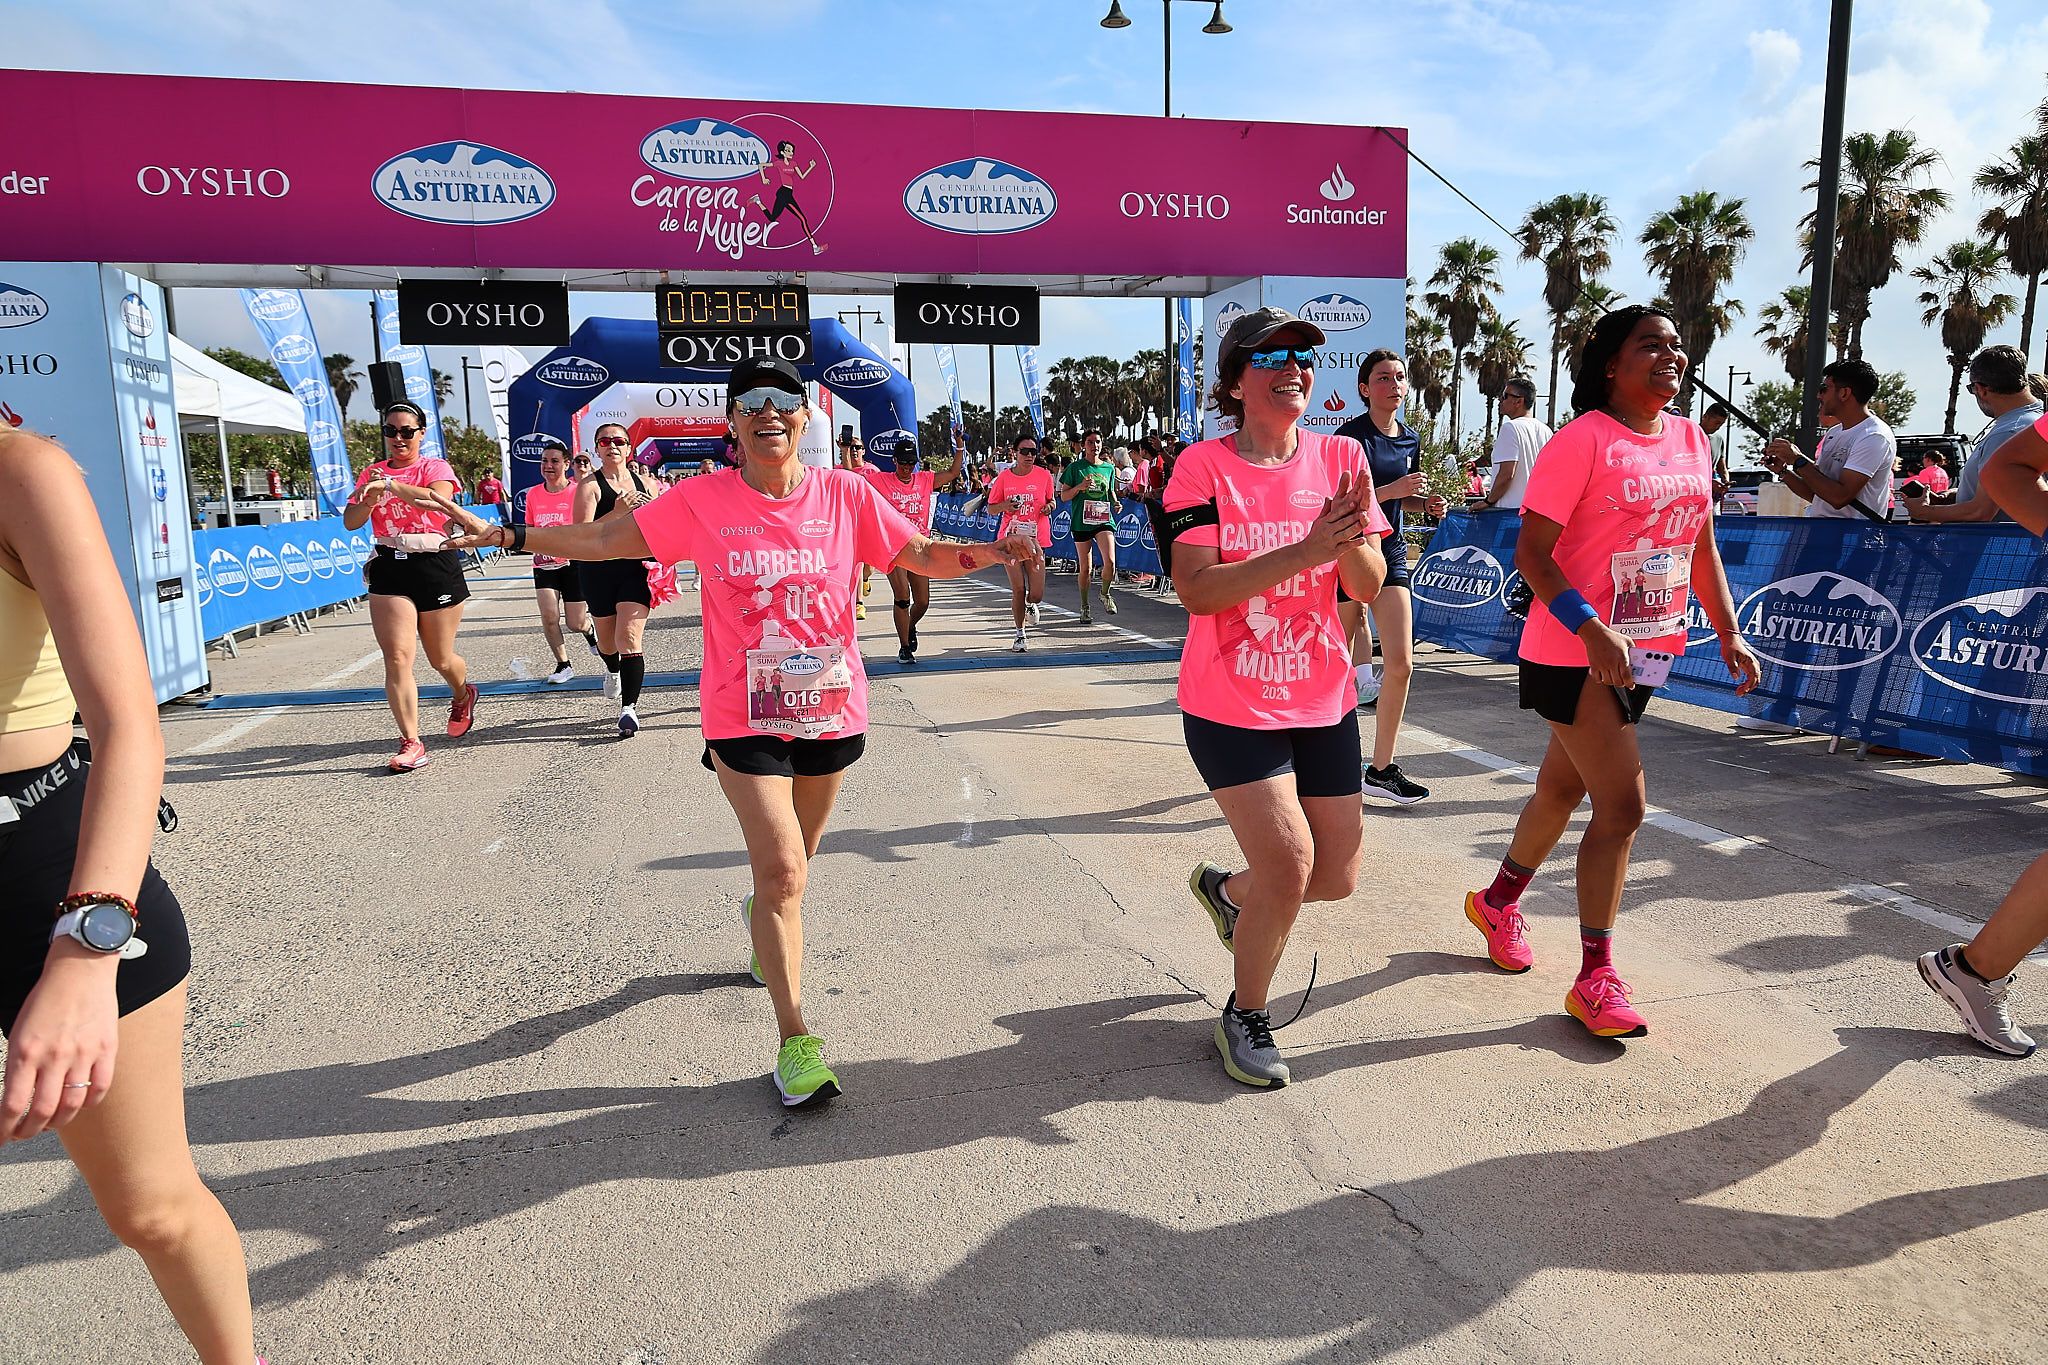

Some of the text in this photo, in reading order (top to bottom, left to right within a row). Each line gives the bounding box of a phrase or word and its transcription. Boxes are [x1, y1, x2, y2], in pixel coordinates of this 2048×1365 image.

[669, 138, 711, 146] CENTRAL
[650, 139, 762, 166] ASTURIANA
[0, 170, 49, 195] der
[136, 165, 290, 198] OYSHO
[414, 168, 535, 180] CENTRAL LECHERA
[388, 170, 543, 204] ASTURIANA
[630, 174, 740, 210] Carrera
[939, 183, 1040, 193] CENTRAL LECHERA
[916, 184, 1046, 215] ASTURIANA
[1119, 191, 1230, 220] OYSHO
[659, 209, 698, 233] de la
[1286, 203, 1387, 225] Santander
[696, 207, 779, 260] Mujer
[0, 304, 41, 317] IANA
[427, 302, 545, 328] OYSHO
[667, 291, 799, 323] 00:36:49
[918, 302, 1020, 328] OYSHO
[1304, 307, 1366, 323] ASTURIANA
[667, 334, 806, 363] OYSHO
[125, 357, 160, 384] OYSHO
[541, 367, 603, 381] ASTURIANA
[829, 370, 888, 382] ASTURIANA
[596, 410, 627, 418] OYSHO
[655, 417, 683, 426] Sports
[801, 447, 828, 455] OYSHO
[1610, 455, 1649, 468] OYSHO
[1622, 474, 1709, 503] CARRERA
[391, 502, 407, 519] DE
[909, 502, 919, 514] DE
[1020, 504, 1029, 516] DE
[720, 525, 764, 537] OYSHO
[801, 524, 832, 534] ASTURIANA
[728, 548, 828, 577] CARRERA
[1415, 563, 1494, 596] ASTURIANA
[785, 584, 815, 620] DE
[1645, 588, 1673, 606] 016
[1773, 601, 1886, 621] CENTRAL LECHERA
[1272, 617, 1296, 653] LA
[1620, 626, 1651, 635] OYSHO
[1742, 601, 1882, 652] ASTURIANA
[1966, 622, 2040, 638] CENTRAL
[783, 662, 821, 671] ASTURIANA
[1235, 647, 1311, 684] MUJER
[783, 690, 822, 707] 016
[1262, 685, 1291, 700] 2026
[796, 708, 809, 716] 621
[760, 720, 793, 730] OYSHO
[11, 762, 68, 815] NIKE
